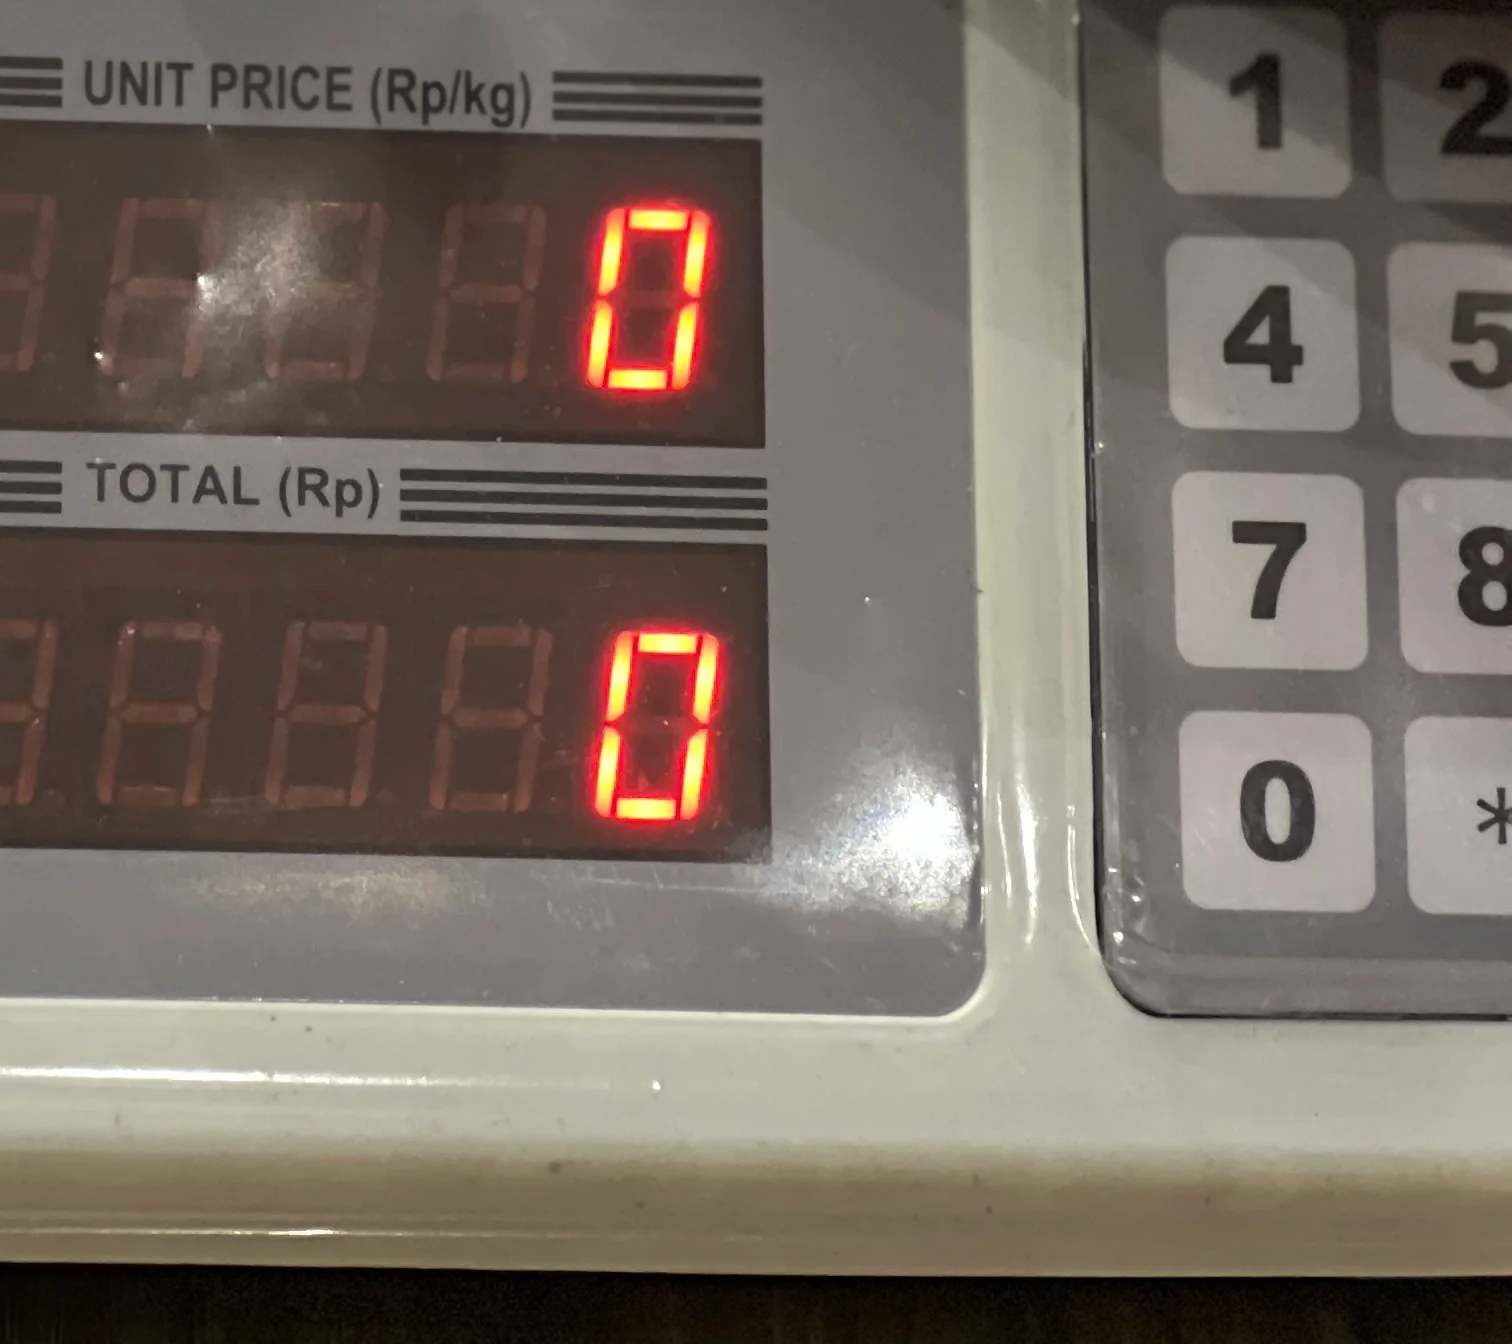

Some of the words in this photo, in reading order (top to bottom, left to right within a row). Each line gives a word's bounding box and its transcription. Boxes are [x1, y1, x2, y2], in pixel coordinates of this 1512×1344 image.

[84, 60, 193, 107] UNIT
[210, 63, 353, 111] PRICE
[370, 68, 533, 129] (Rp/kg)
[1229, 52, 1283, 149] 1
[1439, 58, 1512, 156] 2
[585, 206, 710, 392] 0
[1223, 285, 1304, 384] 4
[1449, 291, 1512, 390] 5
[87, 462, 260, 507] TOTAL
[278, 466, 381, 516] (Rp)
[1232, 521, 1307, 620] 7
[593, 629, 720, 822] 0
[1240, 759, 1316, 863] 0
